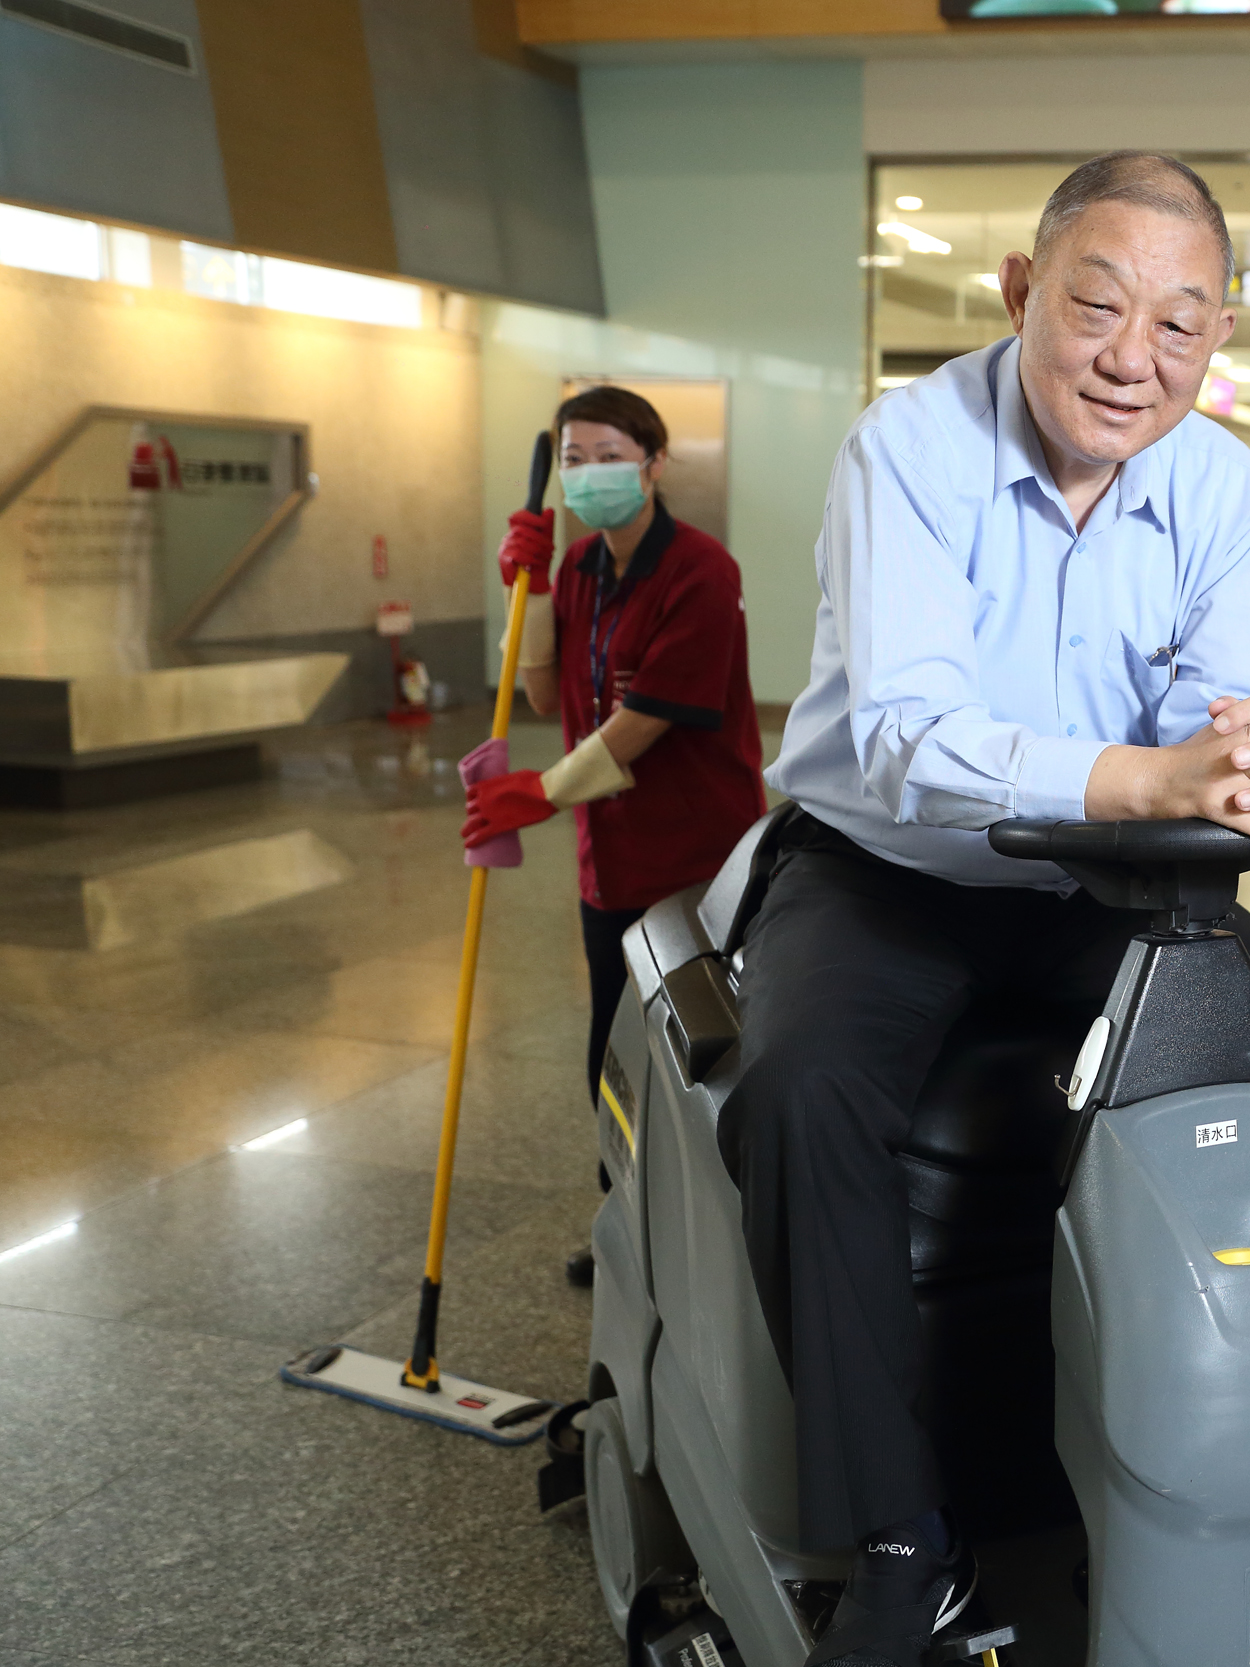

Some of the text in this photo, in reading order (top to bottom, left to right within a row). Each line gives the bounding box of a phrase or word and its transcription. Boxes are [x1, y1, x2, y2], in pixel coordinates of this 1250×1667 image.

[1197, 1124, 1237, 1144] 清水口
[868, 1543, 916, 1557] LANEW
